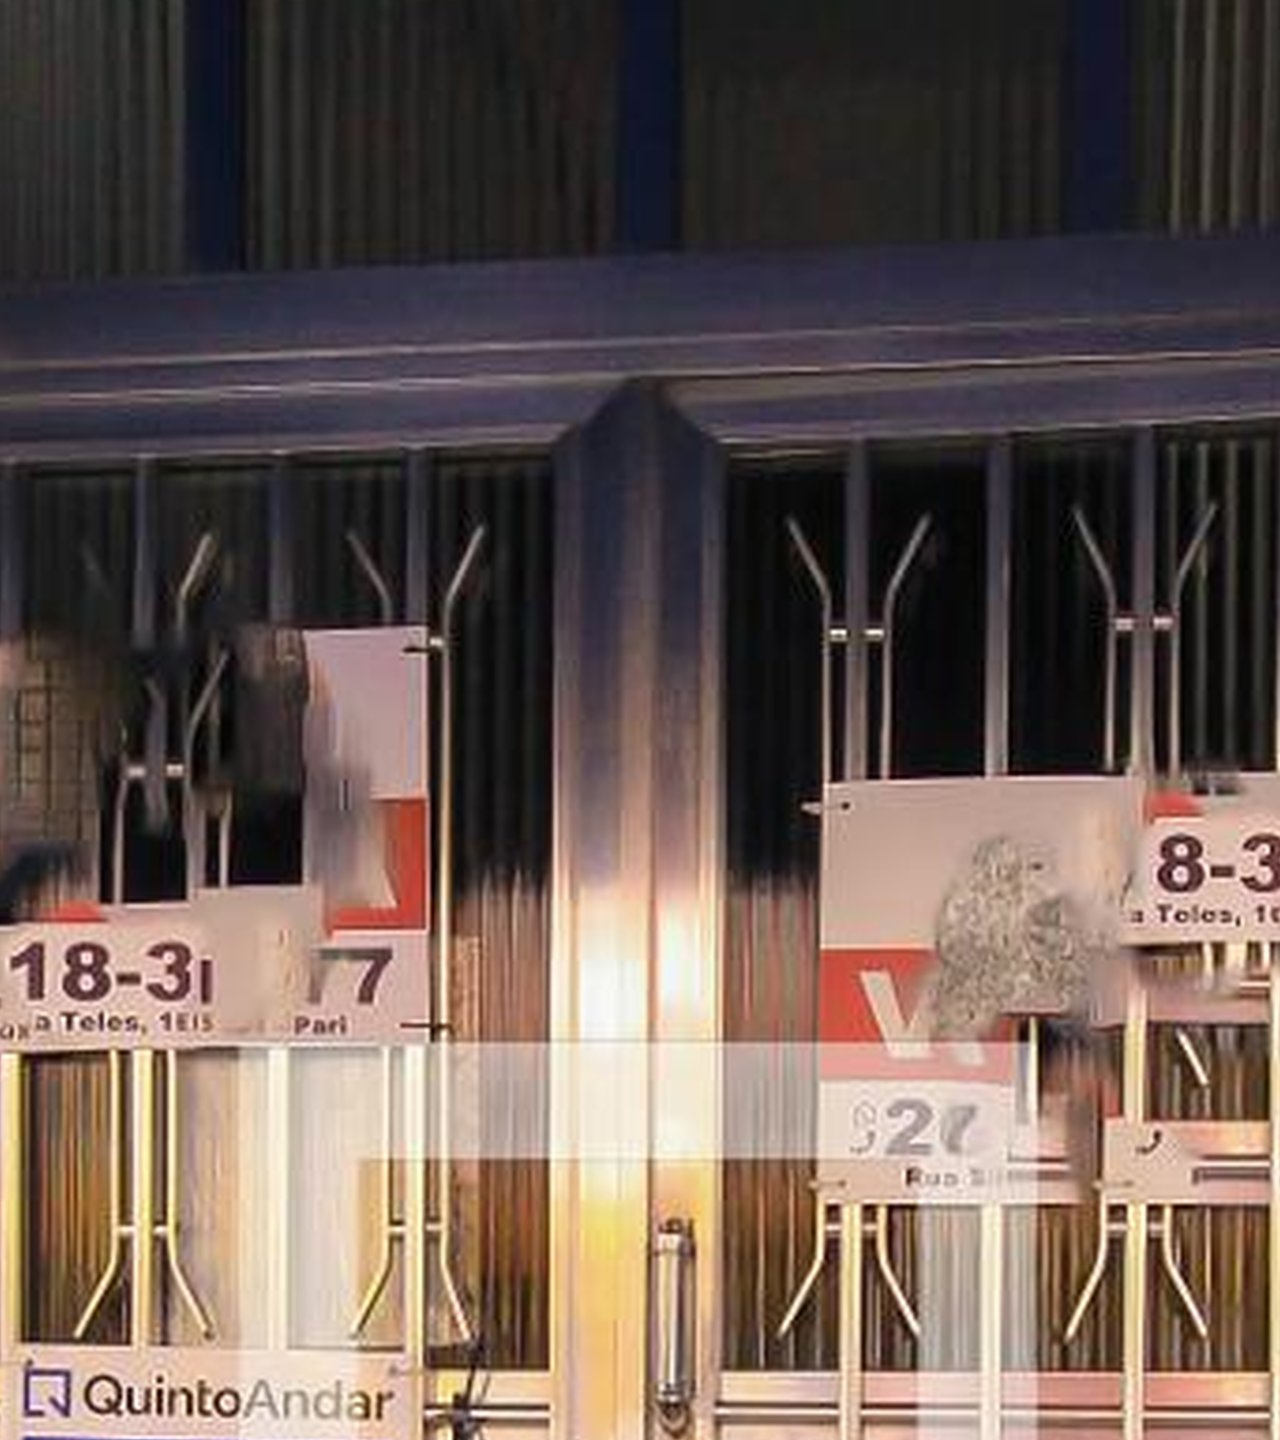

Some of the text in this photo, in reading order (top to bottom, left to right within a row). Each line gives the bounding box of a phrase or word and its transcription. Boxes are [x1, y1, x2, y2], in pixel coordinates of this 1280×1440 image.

[60, 1010, 148, 1035] Teles,
[294, 1014, 348, 1036] Pari
[82, 1373, 394, 1422] QuintoAndar
